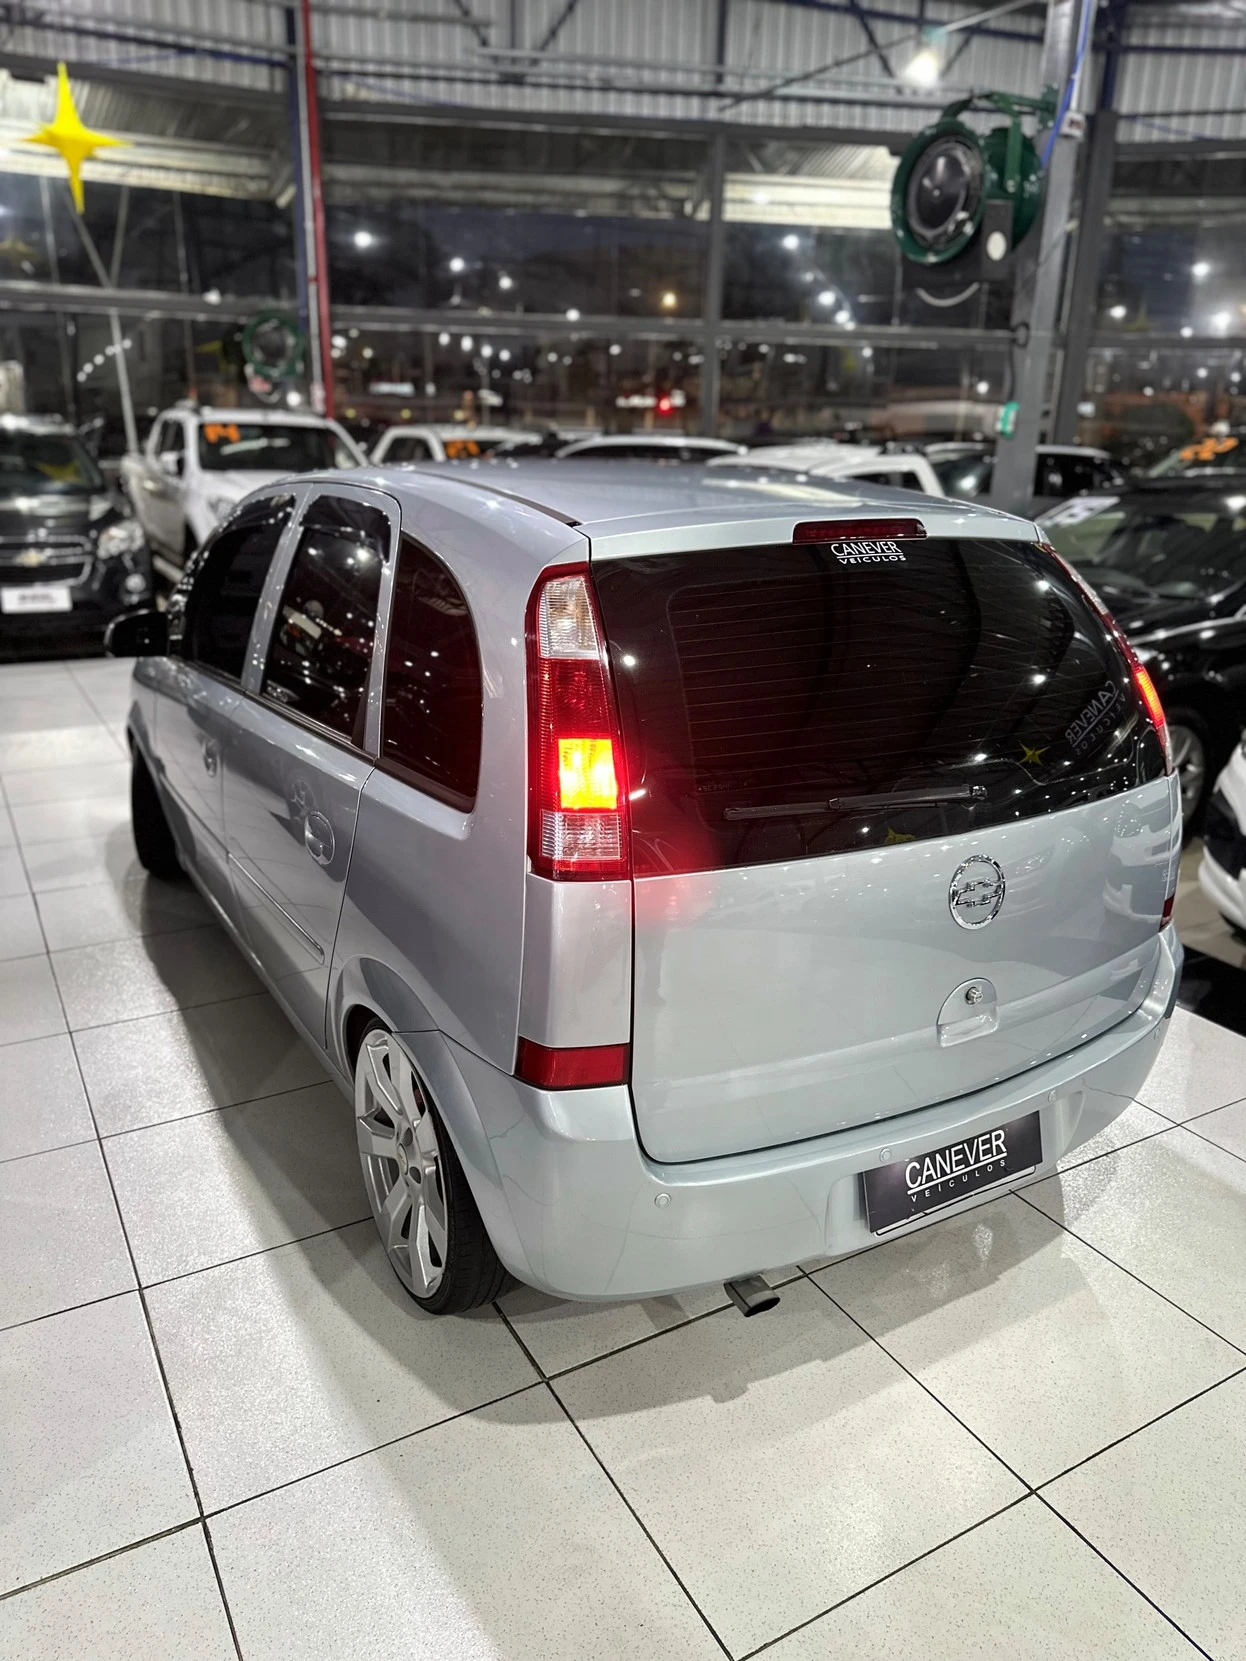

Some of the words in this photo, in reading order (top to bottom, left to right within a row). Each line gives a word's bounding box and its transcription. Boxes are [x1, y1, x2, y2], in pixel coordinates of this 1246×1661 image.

[830, 541, 902, 556] CANEVER
[839, 555, 907, 565] VEICULOS
[905, 1129, 1007, 1188] CANEVER
[911, 1159, 1006, 1203] VEICULOS
